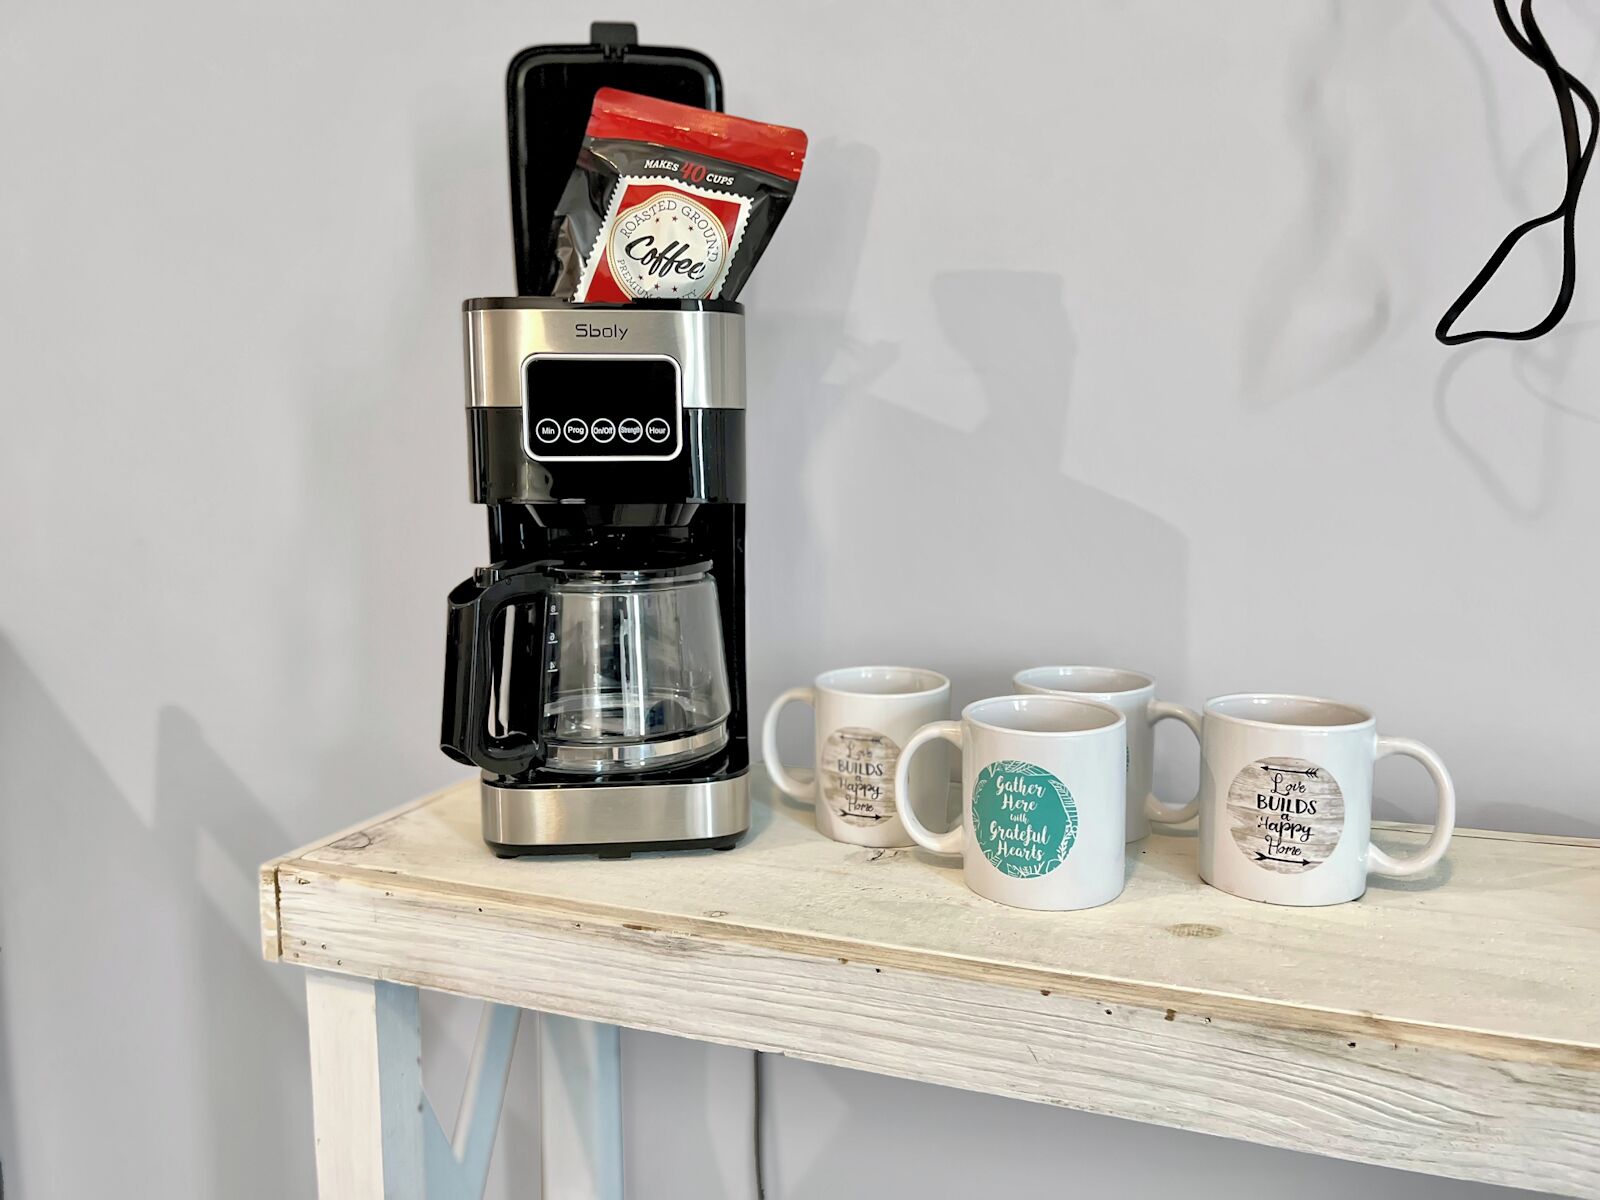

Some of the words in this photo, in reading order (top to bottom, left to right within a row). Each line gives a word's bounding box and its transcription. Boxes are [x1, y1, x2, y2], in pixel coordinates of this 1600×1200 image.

[643, 159, 680, 172] MAKES
[680, 161, 708, 183] 40
[706, 173, 735, 186] CUPS
[619, 199, 677, 239] ROASTED
[681, 205, 719, 263] GROUND
[625, 235, 706, 280] Coffee
[575, 324, 628, 340] Sboly
[541, 427, 555, 435] Min
[567, 426, 584, 436] Prog
[593, 426, 613, 435] On/Off
[649, 426, 666, 435] Hour
[837, 759, 884, 777] BUILDS
[839, 776, 883, 800] Happy
[996, 775, 1046, 798] Gather
[1270, 773, 1307, 797] Love
[845, 794, 874, 812] Home
[1001, 794, 1038, 812] Here
[1256, 793, 1318, 815] BUILDS
[1009, 812, 1030, 825] with
[1280, 813, 1292, 822] a
[989, 820, 1051, 847] Grateful
[1255, 815, 1315, 843] Happy
[996, 839, 1046, 862] Hearts
[1264, 834, 1302, 856] Home
